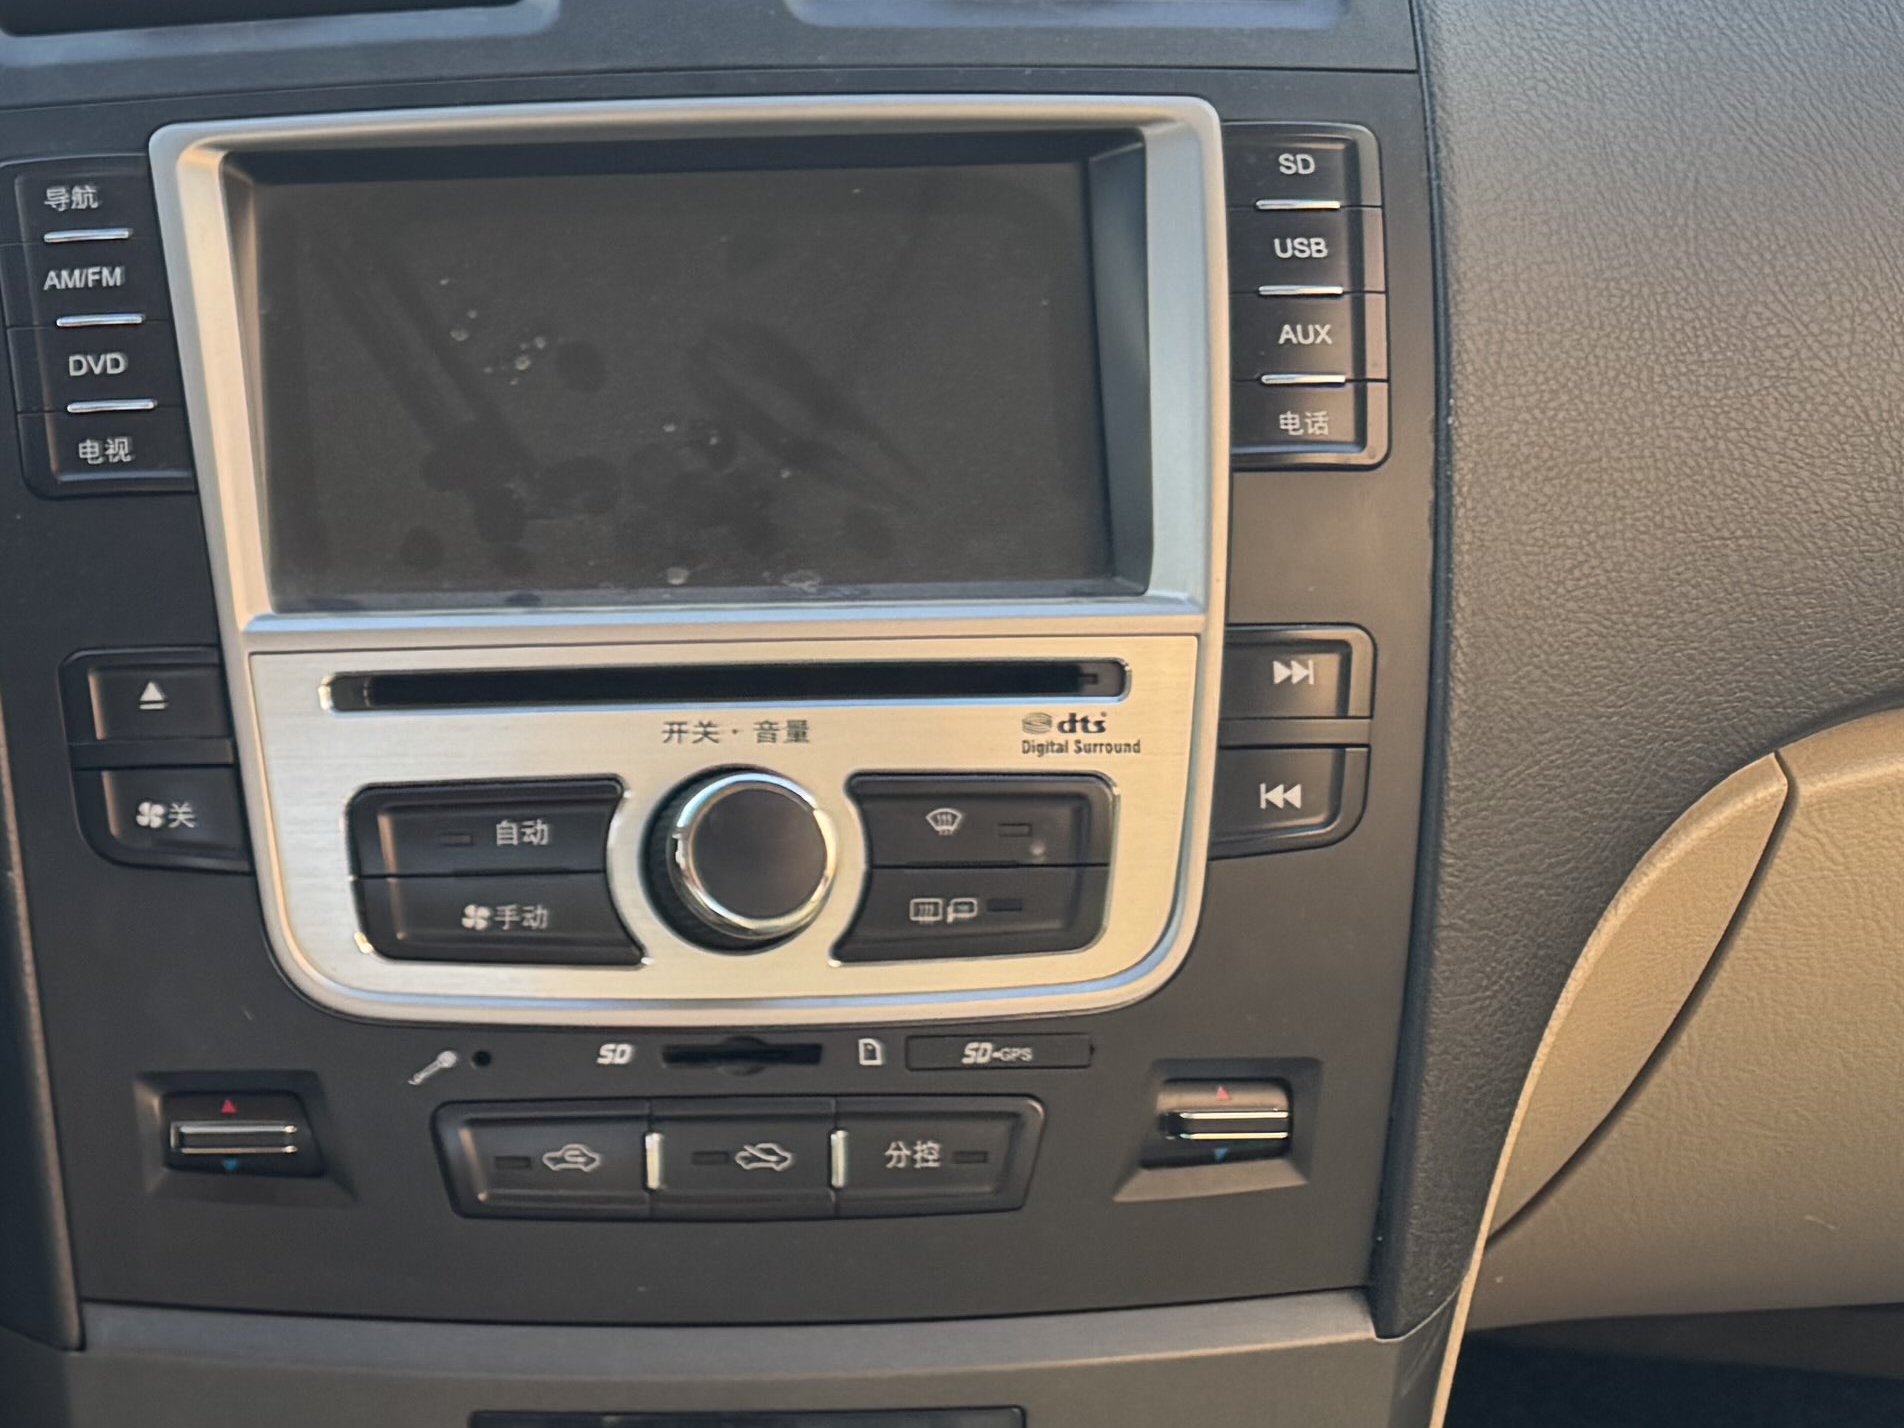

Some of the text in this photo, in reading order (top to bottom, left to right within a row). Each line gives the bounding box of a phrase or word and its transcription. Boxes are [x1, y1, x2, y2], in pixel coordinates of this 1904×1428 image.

[1278, 153, 1315, 175] SD
[44, 184, 100, 212] 导航
[1273, 237, 1329, 259] USB
[43, 266, 125, 291] AM/FM
[1278, 323, 1333, 345] AUX
[68, 352, 128, 377] DVD
[1278, 410, 1330, 436] 电话
[78, 436, 135, 465] 电视
[1021, 739, 1141, 758] Digital Surround
[168, 802, 196, 828] 关
[495, 818, 550, 846] 自动
[493, 904, 550, 930] 手动
[596, 1043, 633, 1065] SD
[884, 1140, 941, 1169] 分控
